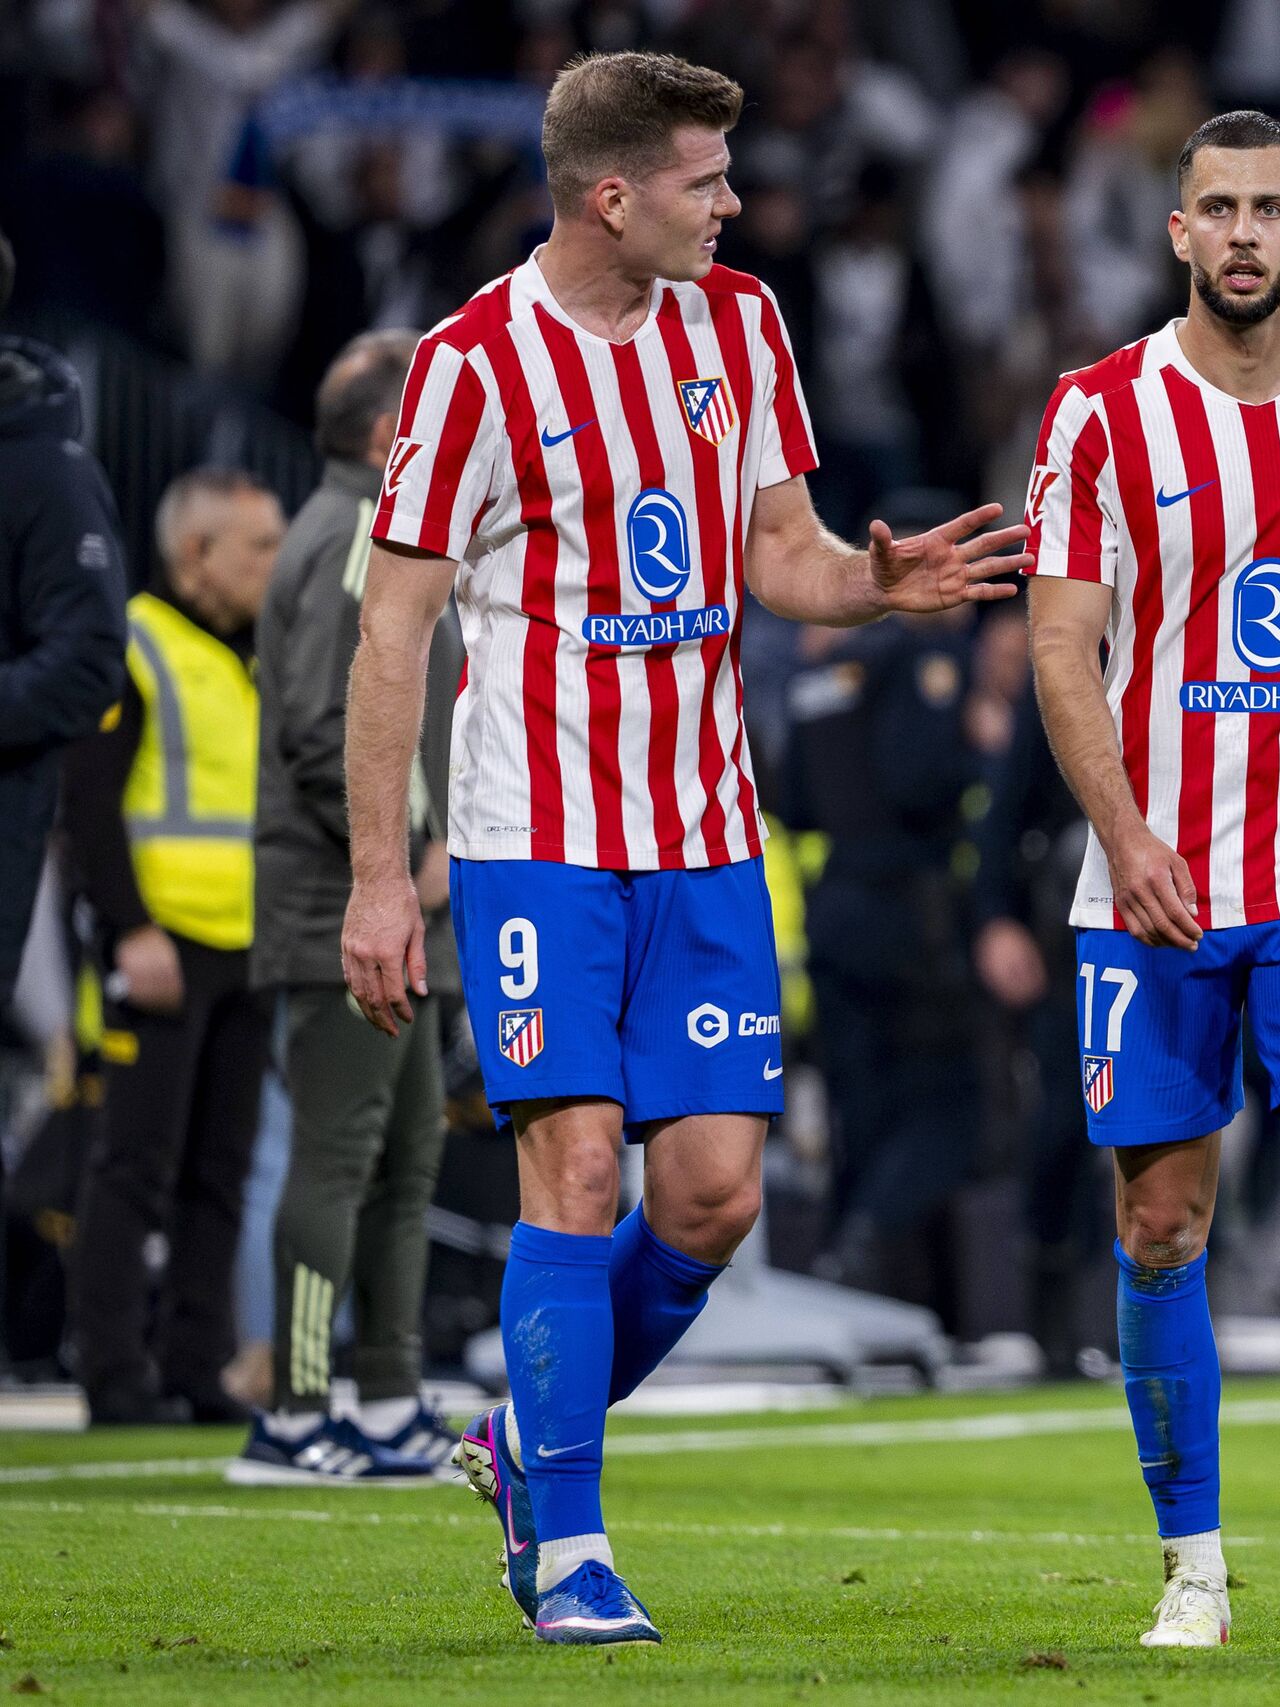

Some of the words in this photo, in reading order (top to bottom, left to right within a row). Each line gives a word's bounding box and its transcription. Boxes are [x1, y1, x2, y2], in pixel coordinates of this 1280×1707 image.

[590, 615, 685, 642] RIYADH
[691, 608, 725, 636] AIR
[499, 917, 539, 1000] 9
[1080, 962, 1138, 1052] 17
